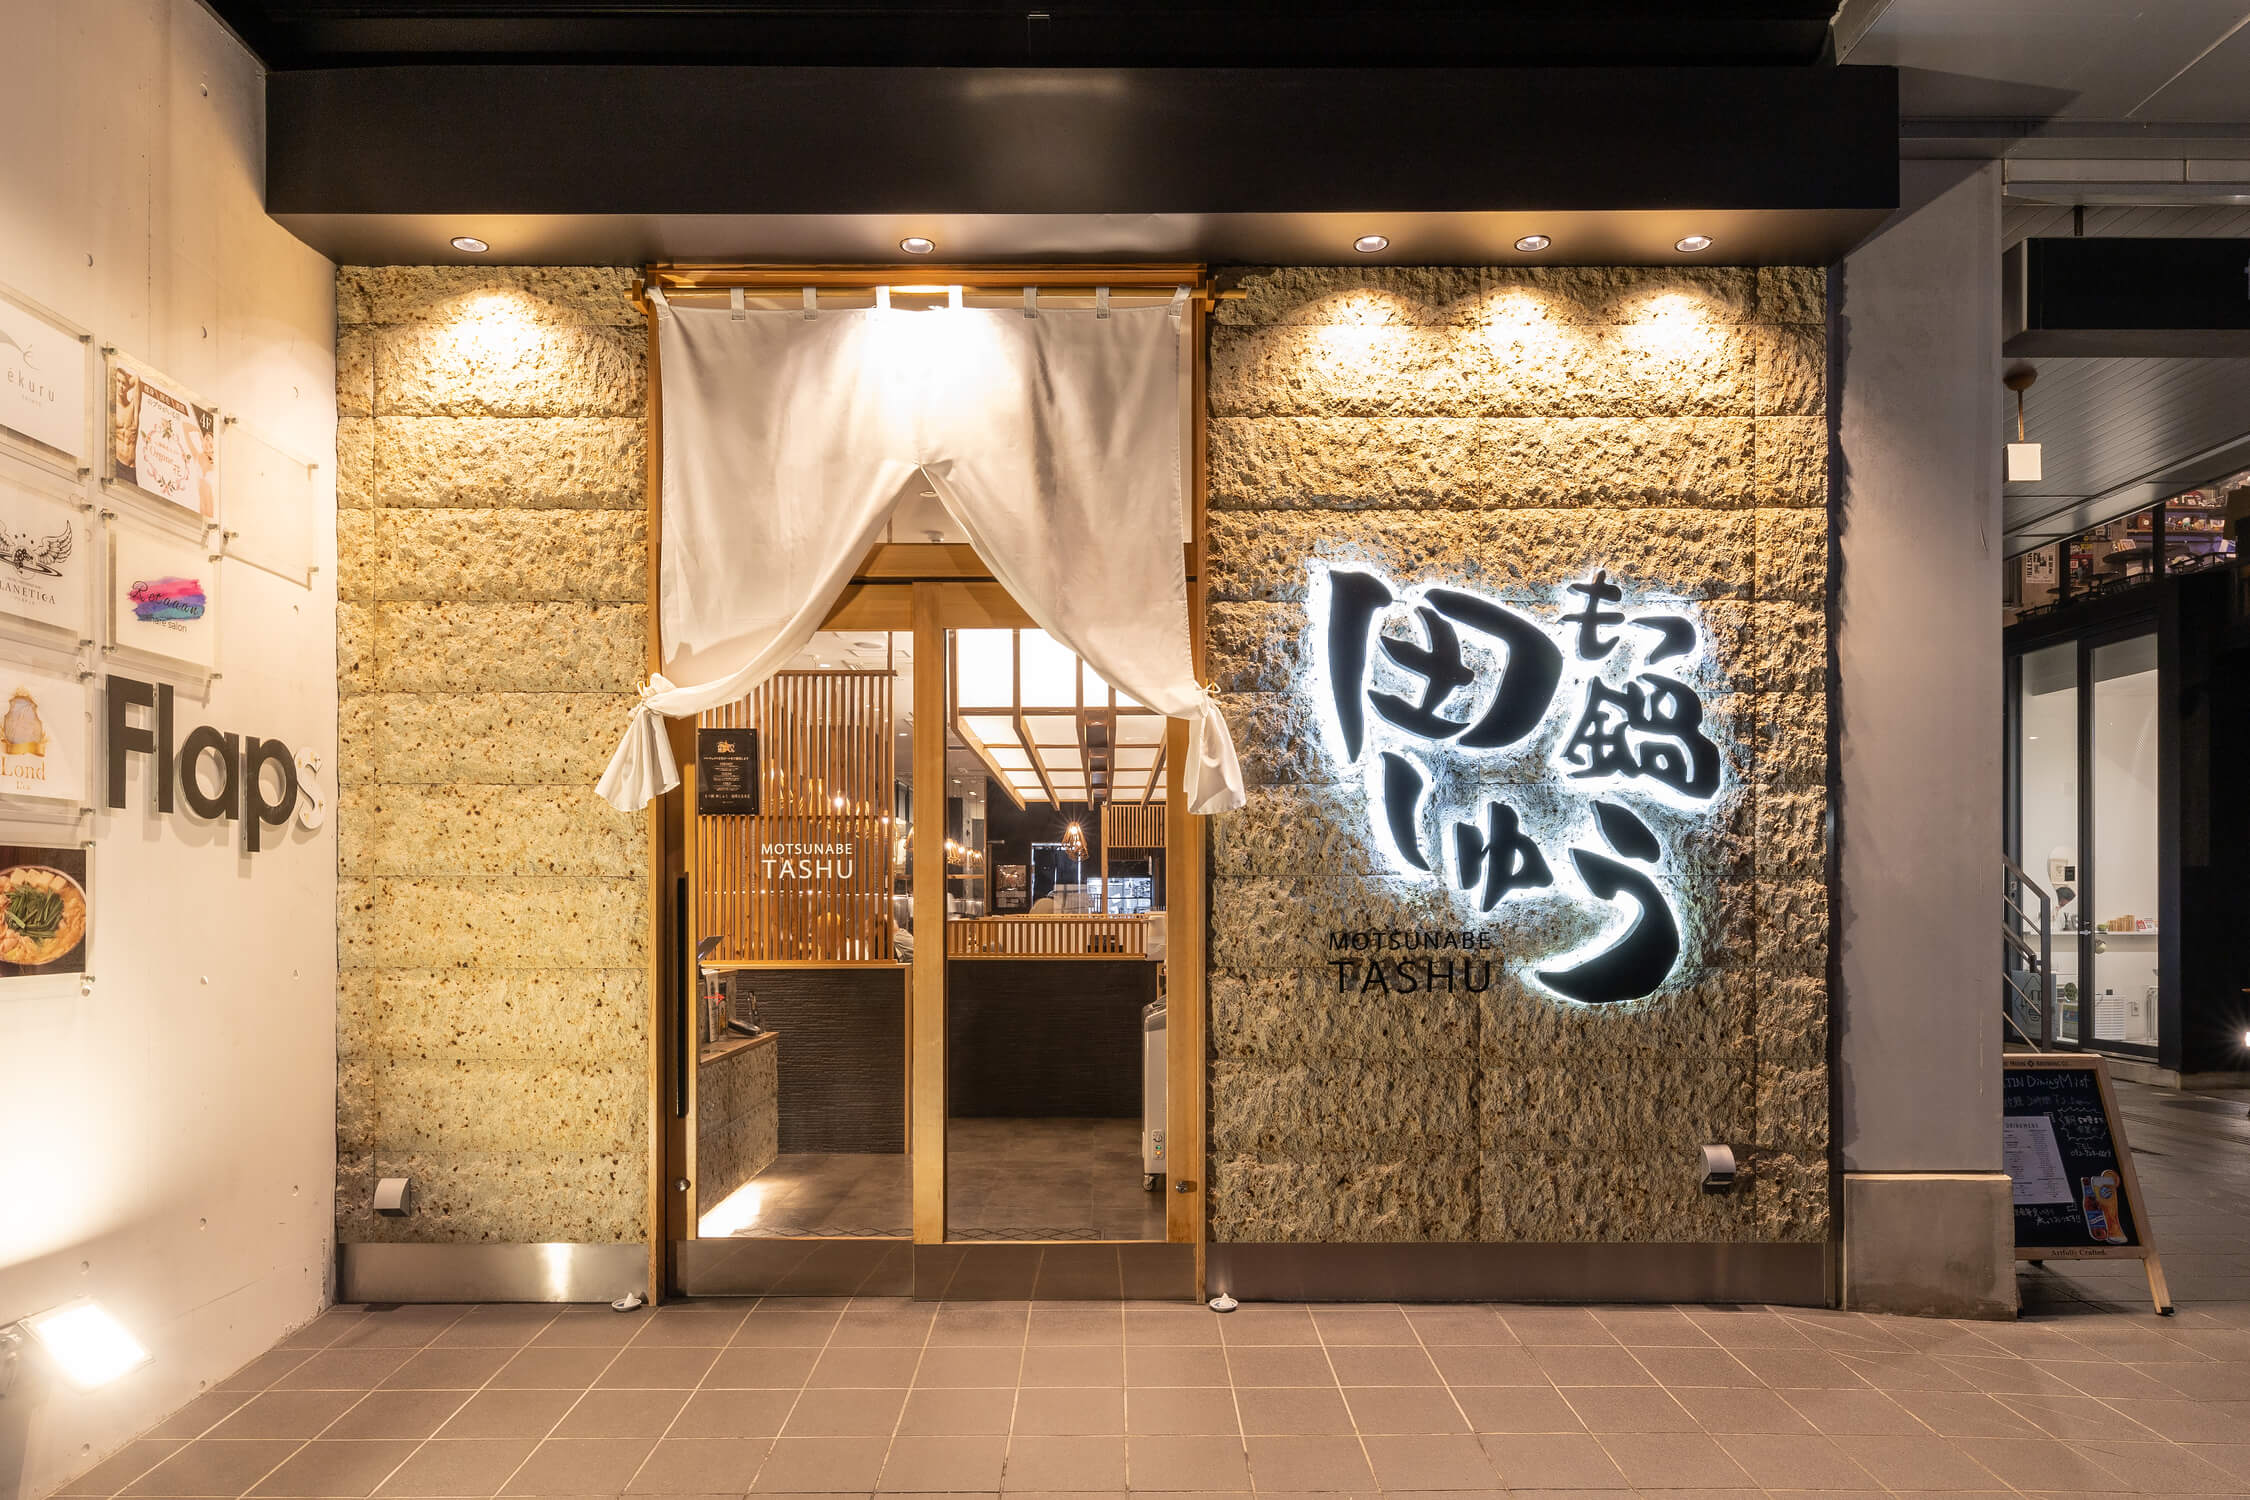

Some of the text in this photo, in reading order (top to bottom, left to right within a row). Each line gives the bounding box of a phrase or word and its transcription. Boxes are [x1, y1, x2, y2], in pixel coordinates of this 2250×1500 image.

[199, 412, 212, 430] 4F
[167, 621, 188, 633] salon
[0, 756, 46, 781] Lond
[106, 674, 324, 852] Flaps
[761, 843, 853, 855] MOTSUNABE
[761, 859, 853, 879] TASHU
[1328, 931, 1491, 950] MOTSUNABE
[1328, 960, 1491, 994] TASHU
